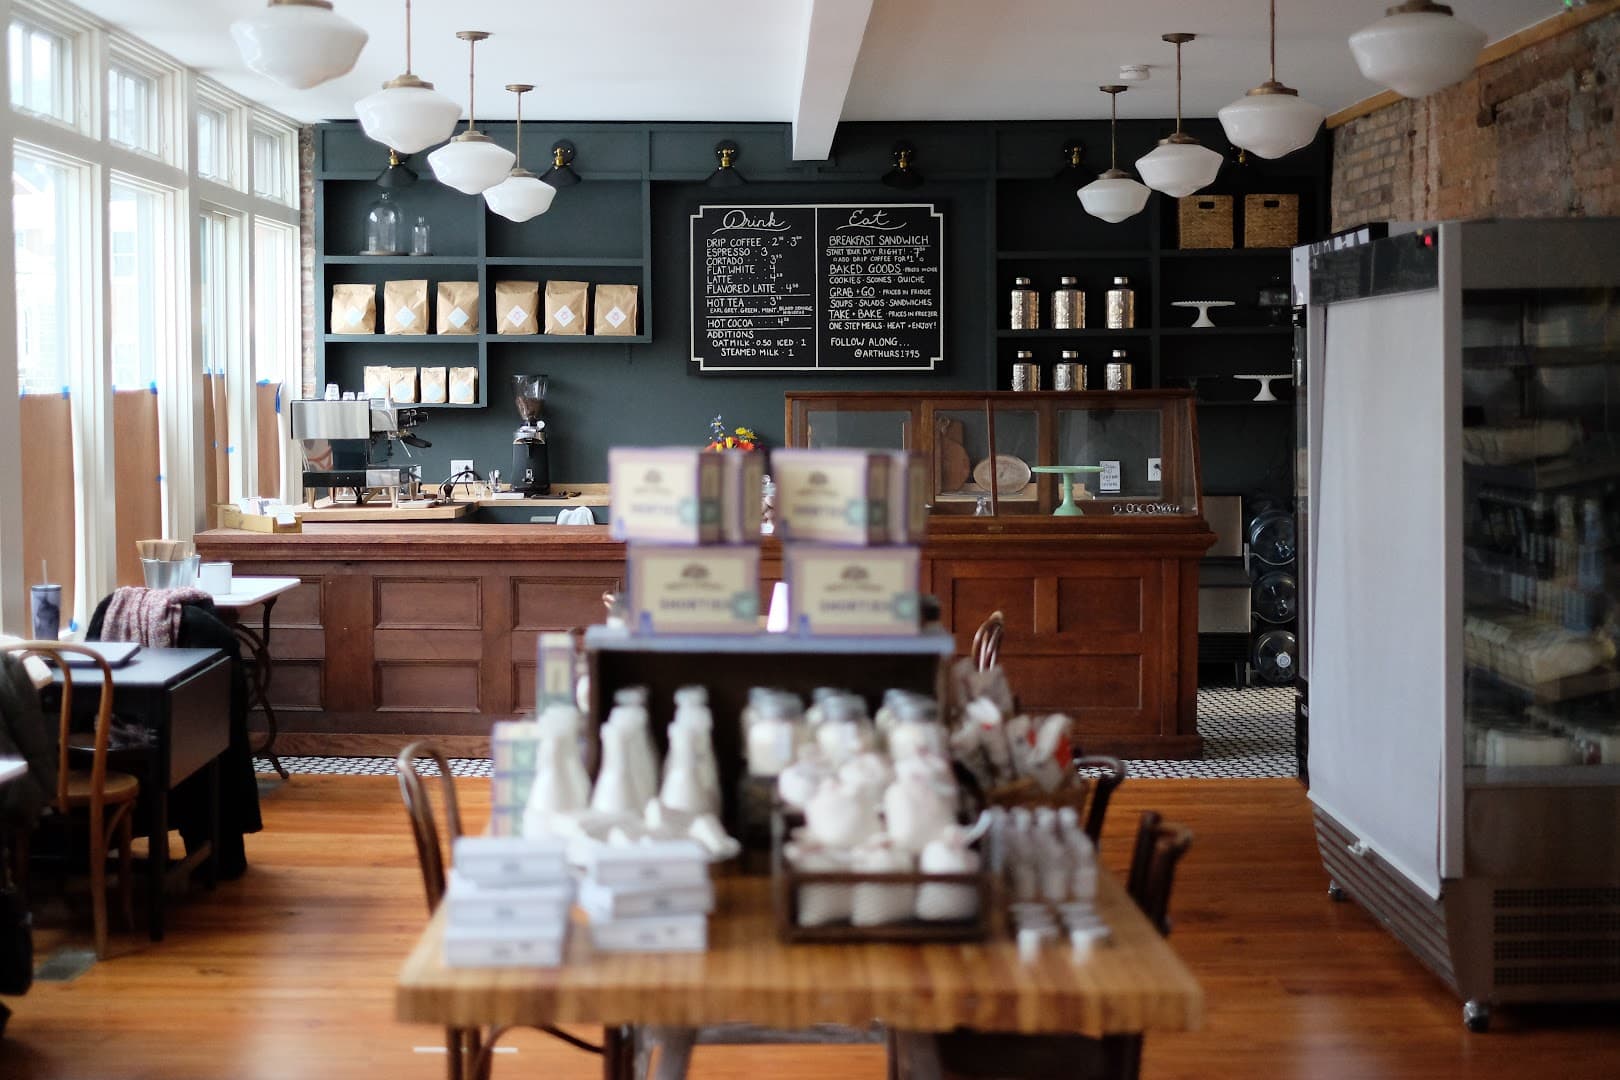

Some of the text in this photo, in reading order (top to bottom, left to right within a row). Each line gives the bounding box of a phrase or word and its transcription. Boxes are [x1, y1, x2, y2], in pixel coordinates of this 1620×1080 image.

[723, 210, 785, 228] Drink
[849, 209, 890, 225] Eat
[706, 238, 726, 248] DRIP
[730, 238, 761, 247] COFFEE
[829, 235, 929, 246] BREAKFAST SANDWICH
[706, 247, 768, 257] ESPRESSO 3
[706, 257, 744, 266] CORTADO
[707, 266, 726, 275] FLAT
[728, 265, 755, 274] WHITE
[829, 264, 863, 274] BAKED
[868, 263, 901, 274] GOODS
[707, 275, 733, 284] LATTE
[829, 276, 925, 284] COOKIES SCONES QUICHE
[706, 284, 750, 294] FLAVORED
[752, 284, 776, 293] LATTE
[829, 287, 853, 297] GRAB
[861, 286, 875, 297] GO
[706, 298, 724, 308] HOT
[727, 298, 744, 307] TEA
[830, 299, 932, 308] SOUPS SALADS SANDWICHES
[828, 309, 850, 319] TAKE
[858, 309, 883, 319] BAKE
[708, 319, 726, 328] HOT
[728, 318, 754, 328] COCOA
[828, 322, 844, 330] ONE
[844, 322, 860, 330] STEP
[861, 322, 882, 330] MEALS
[707, 330, 754, 339] ADDITIONS
[830, 337, 865, 347] FOLLOW
[721, 348, 756, 356] STEAMED
[760, 348, 779, 356] MILK
[854, 349, 920, 358] @ARTHURS1795
